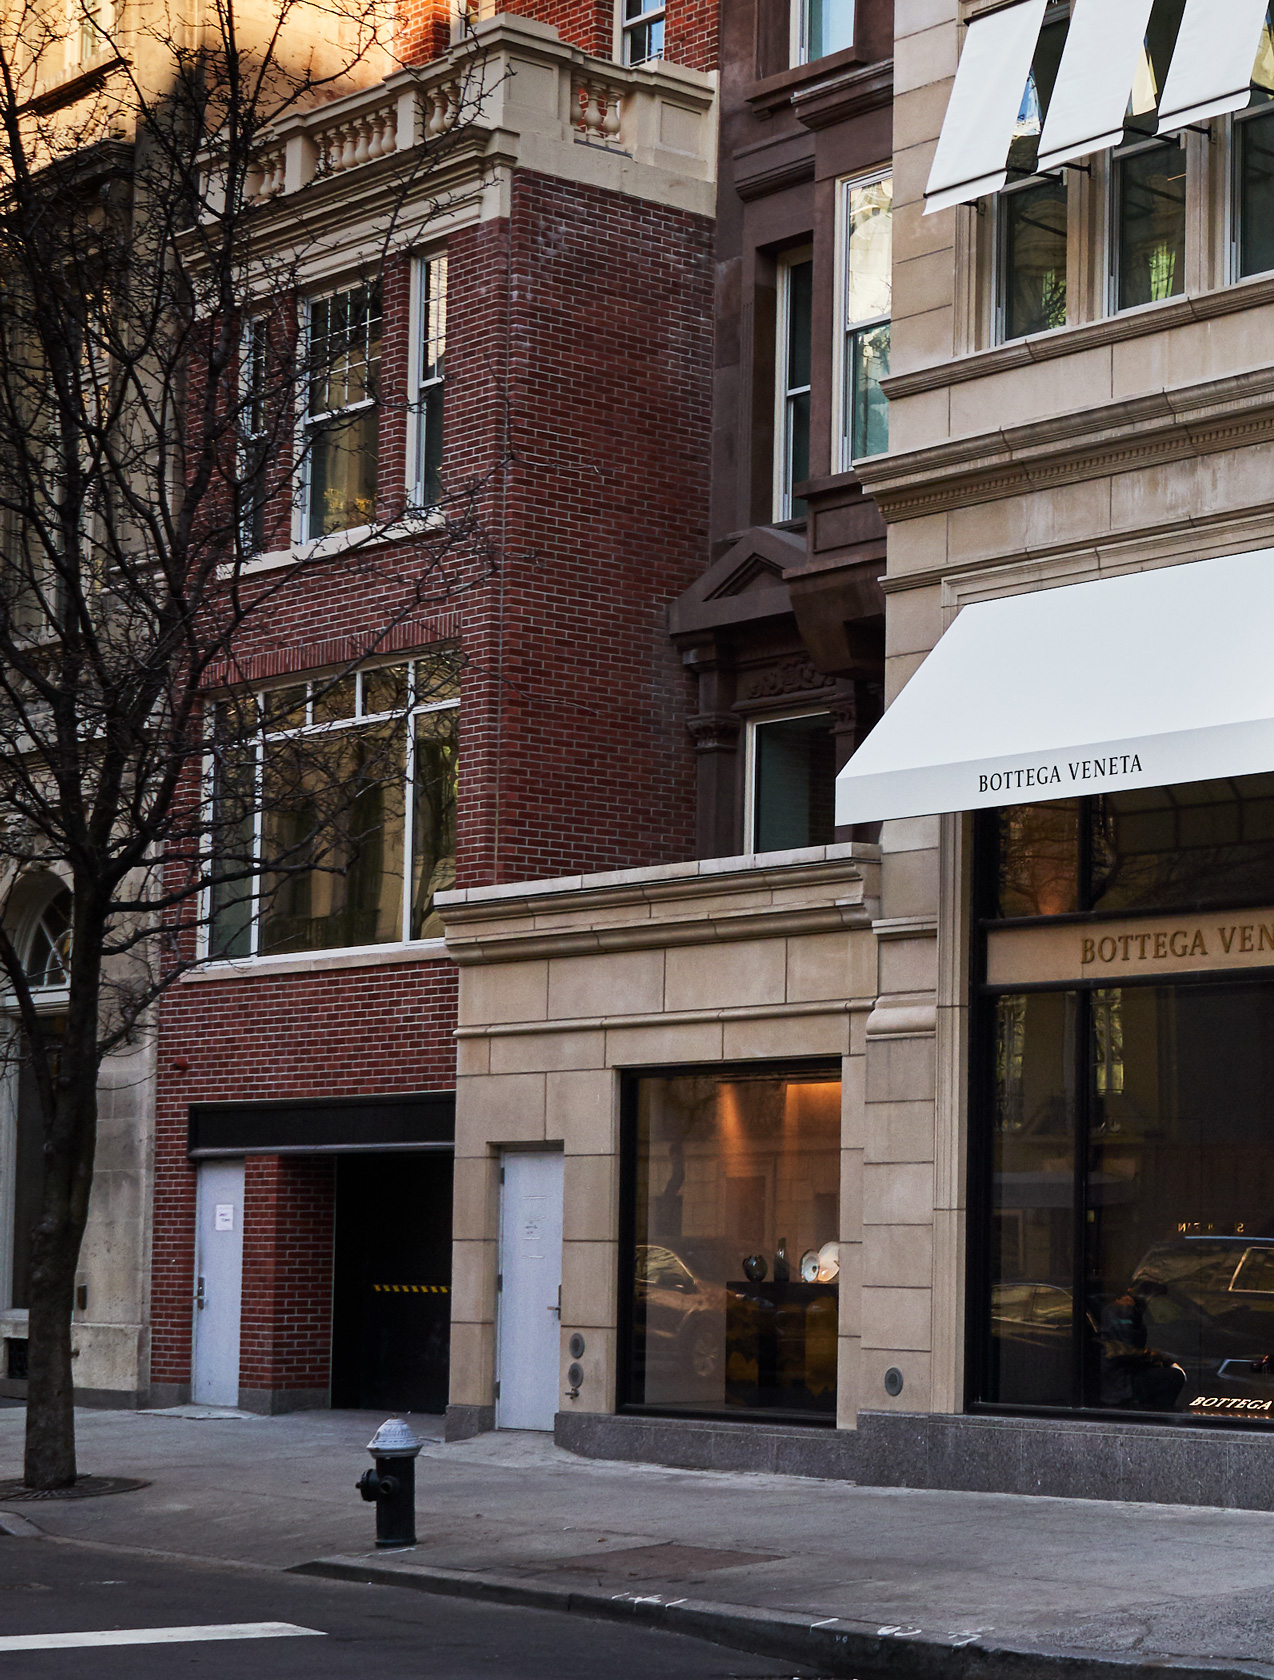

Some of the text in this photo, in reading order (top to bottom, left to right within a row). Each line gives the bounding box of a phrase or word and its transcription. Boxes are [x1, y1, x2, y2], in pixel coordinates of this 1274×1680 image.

[978, 754, 1143, 793] BOTTEGA VENETA
[1080, 929, 1208, 964] BOTTEGA
[1189, 1396, 1273, 1411] BOTTEGA
